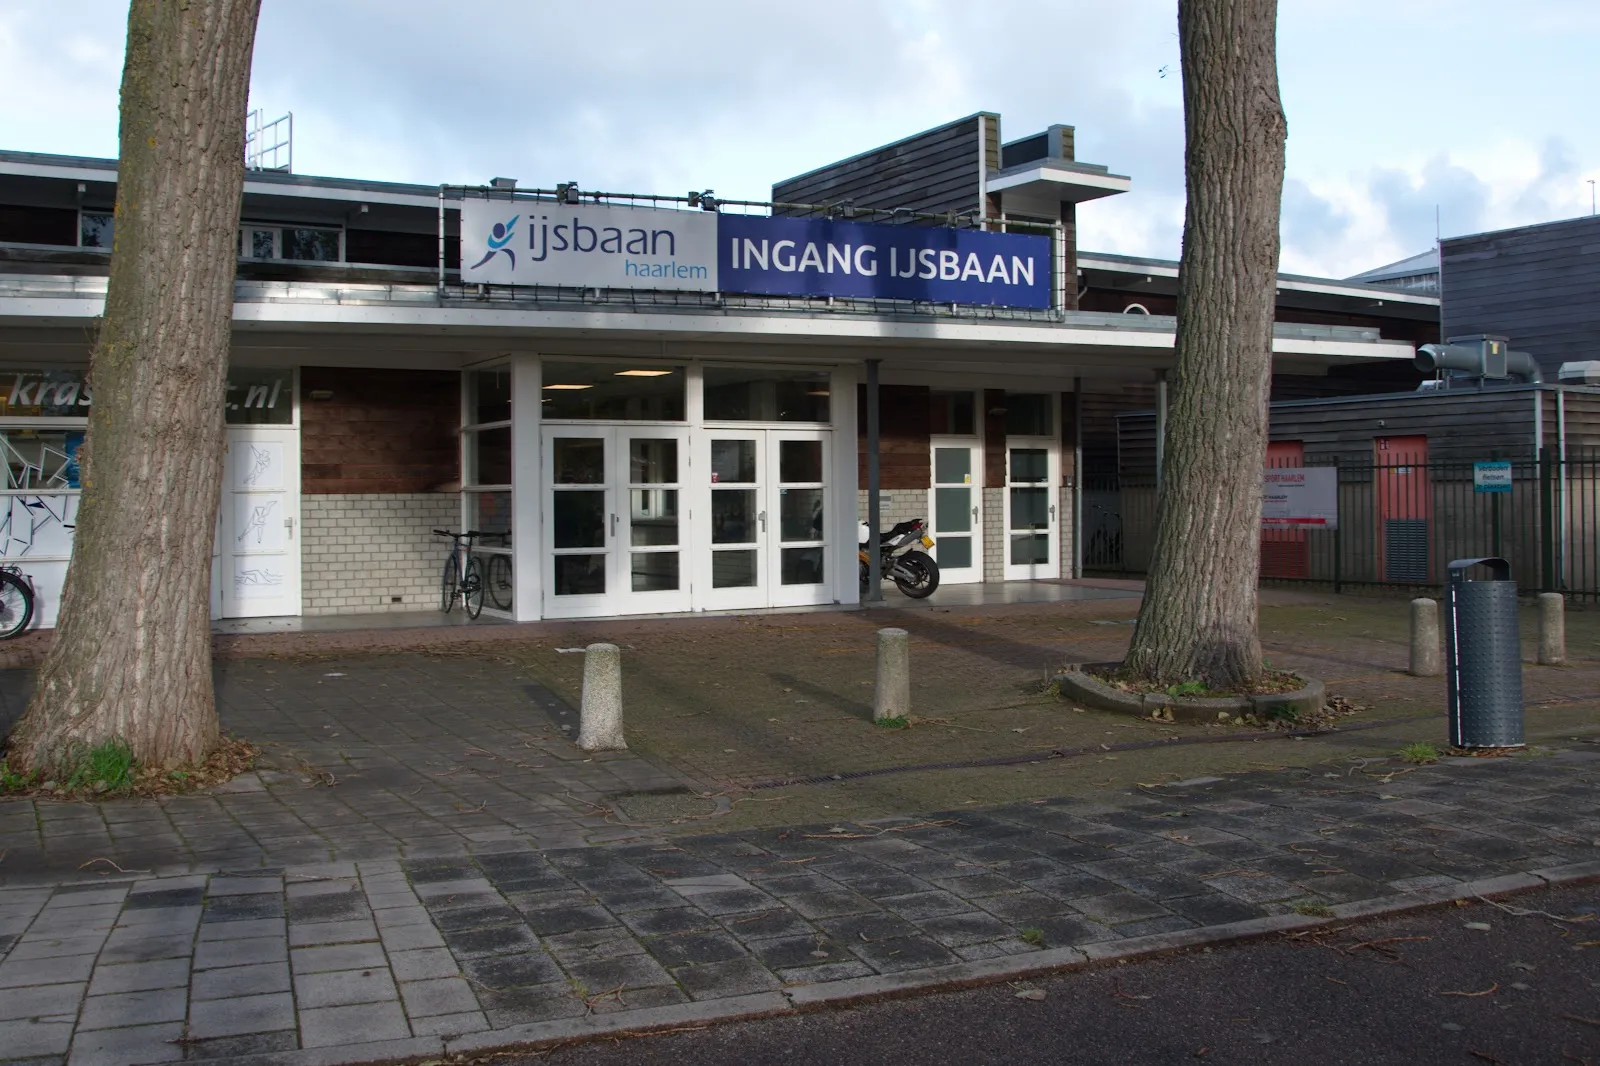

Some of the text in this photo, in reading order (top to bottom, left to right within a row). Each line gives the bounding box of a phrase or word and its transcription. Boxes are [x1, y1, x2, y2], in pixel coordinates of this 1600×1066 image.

[528, 214, 676, 262] ijsbaan
[731, 236, 1035, 286] INGANG IJSBAAN
[624, 258, 708, 280] haarlem
